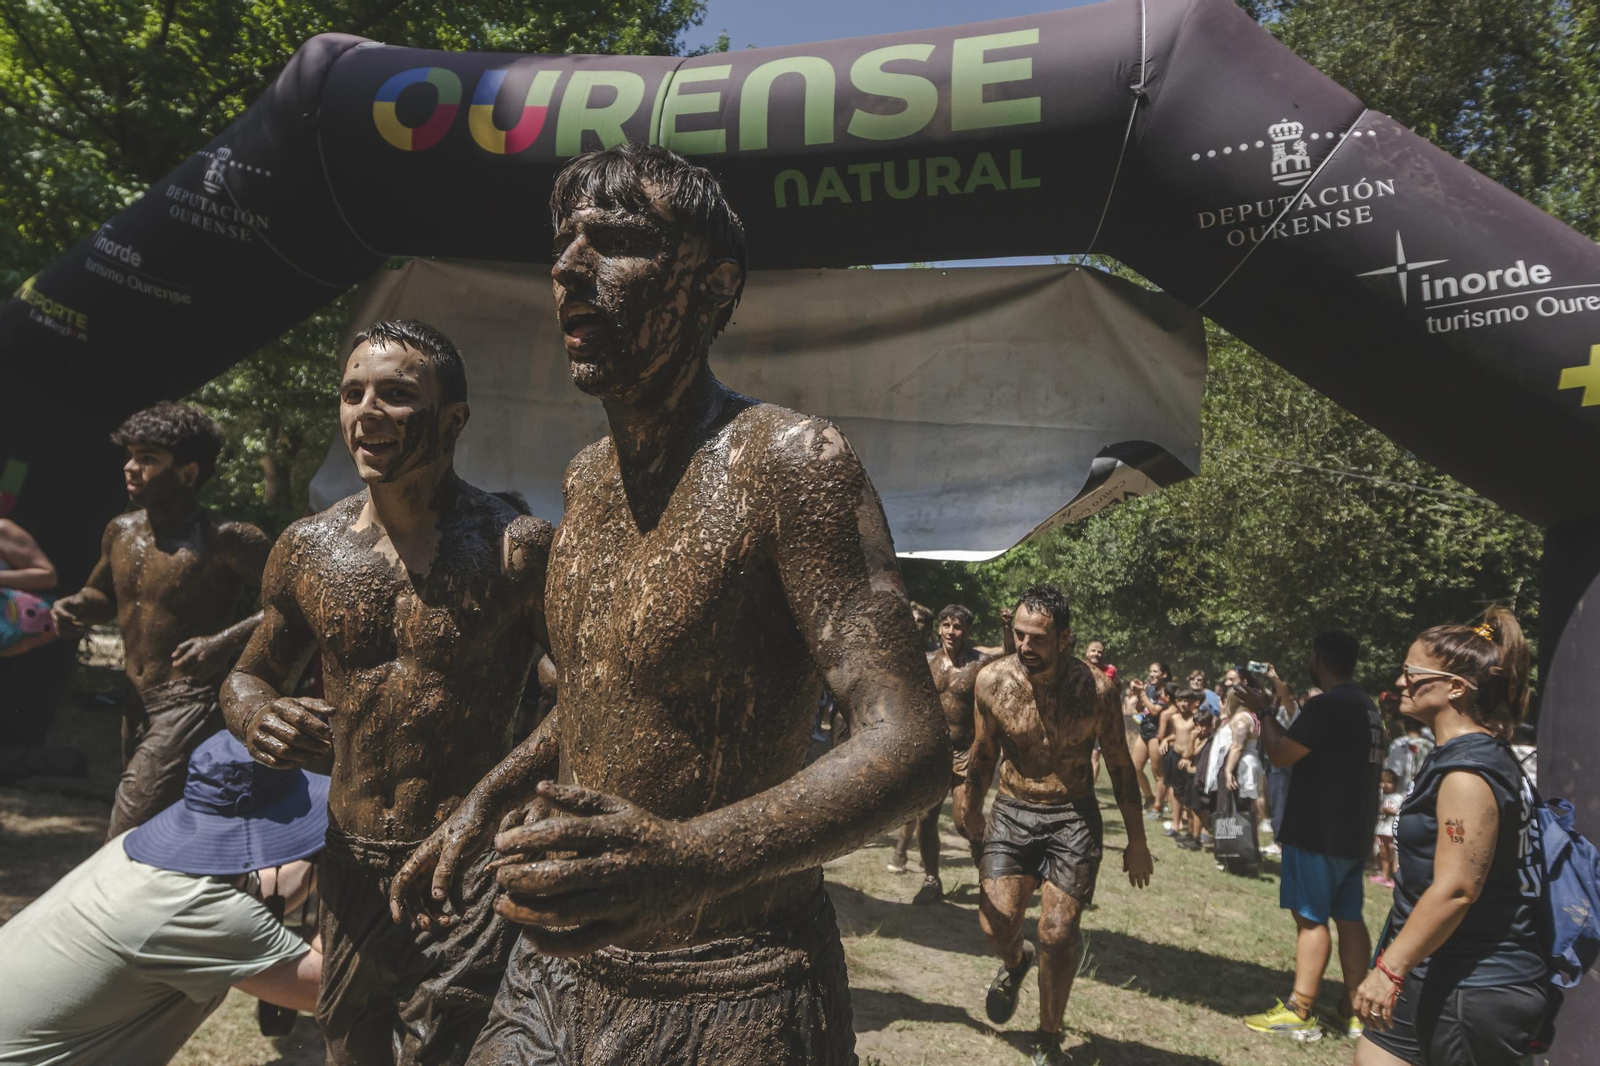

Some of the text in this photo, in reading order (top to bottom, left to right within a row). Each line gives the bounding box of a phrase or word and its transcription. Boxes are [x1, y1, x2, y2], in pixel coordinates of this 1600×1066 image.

[372, 27, 1042, 158] OURENSE
[773, 148, 1042, 208] NATURAL
[165, 183, 271, 230] DEPUTACIÓN
[1197, 176, 1396, 229] DEPUTACIÓN
[168, 204, 252, 243] OURENSE
[1226, 204, 1374, 247] OURENSE
[93, 231, 143, 268] inorde
[126, 274, 194, 305] Ourense
[1420, 259, 1552, 302] inorde
[1425, 295, 1600, 334] turismo Oure
[1092, 480, 1127, 507] Centro
[1450, 835, 1465, 844] 159
